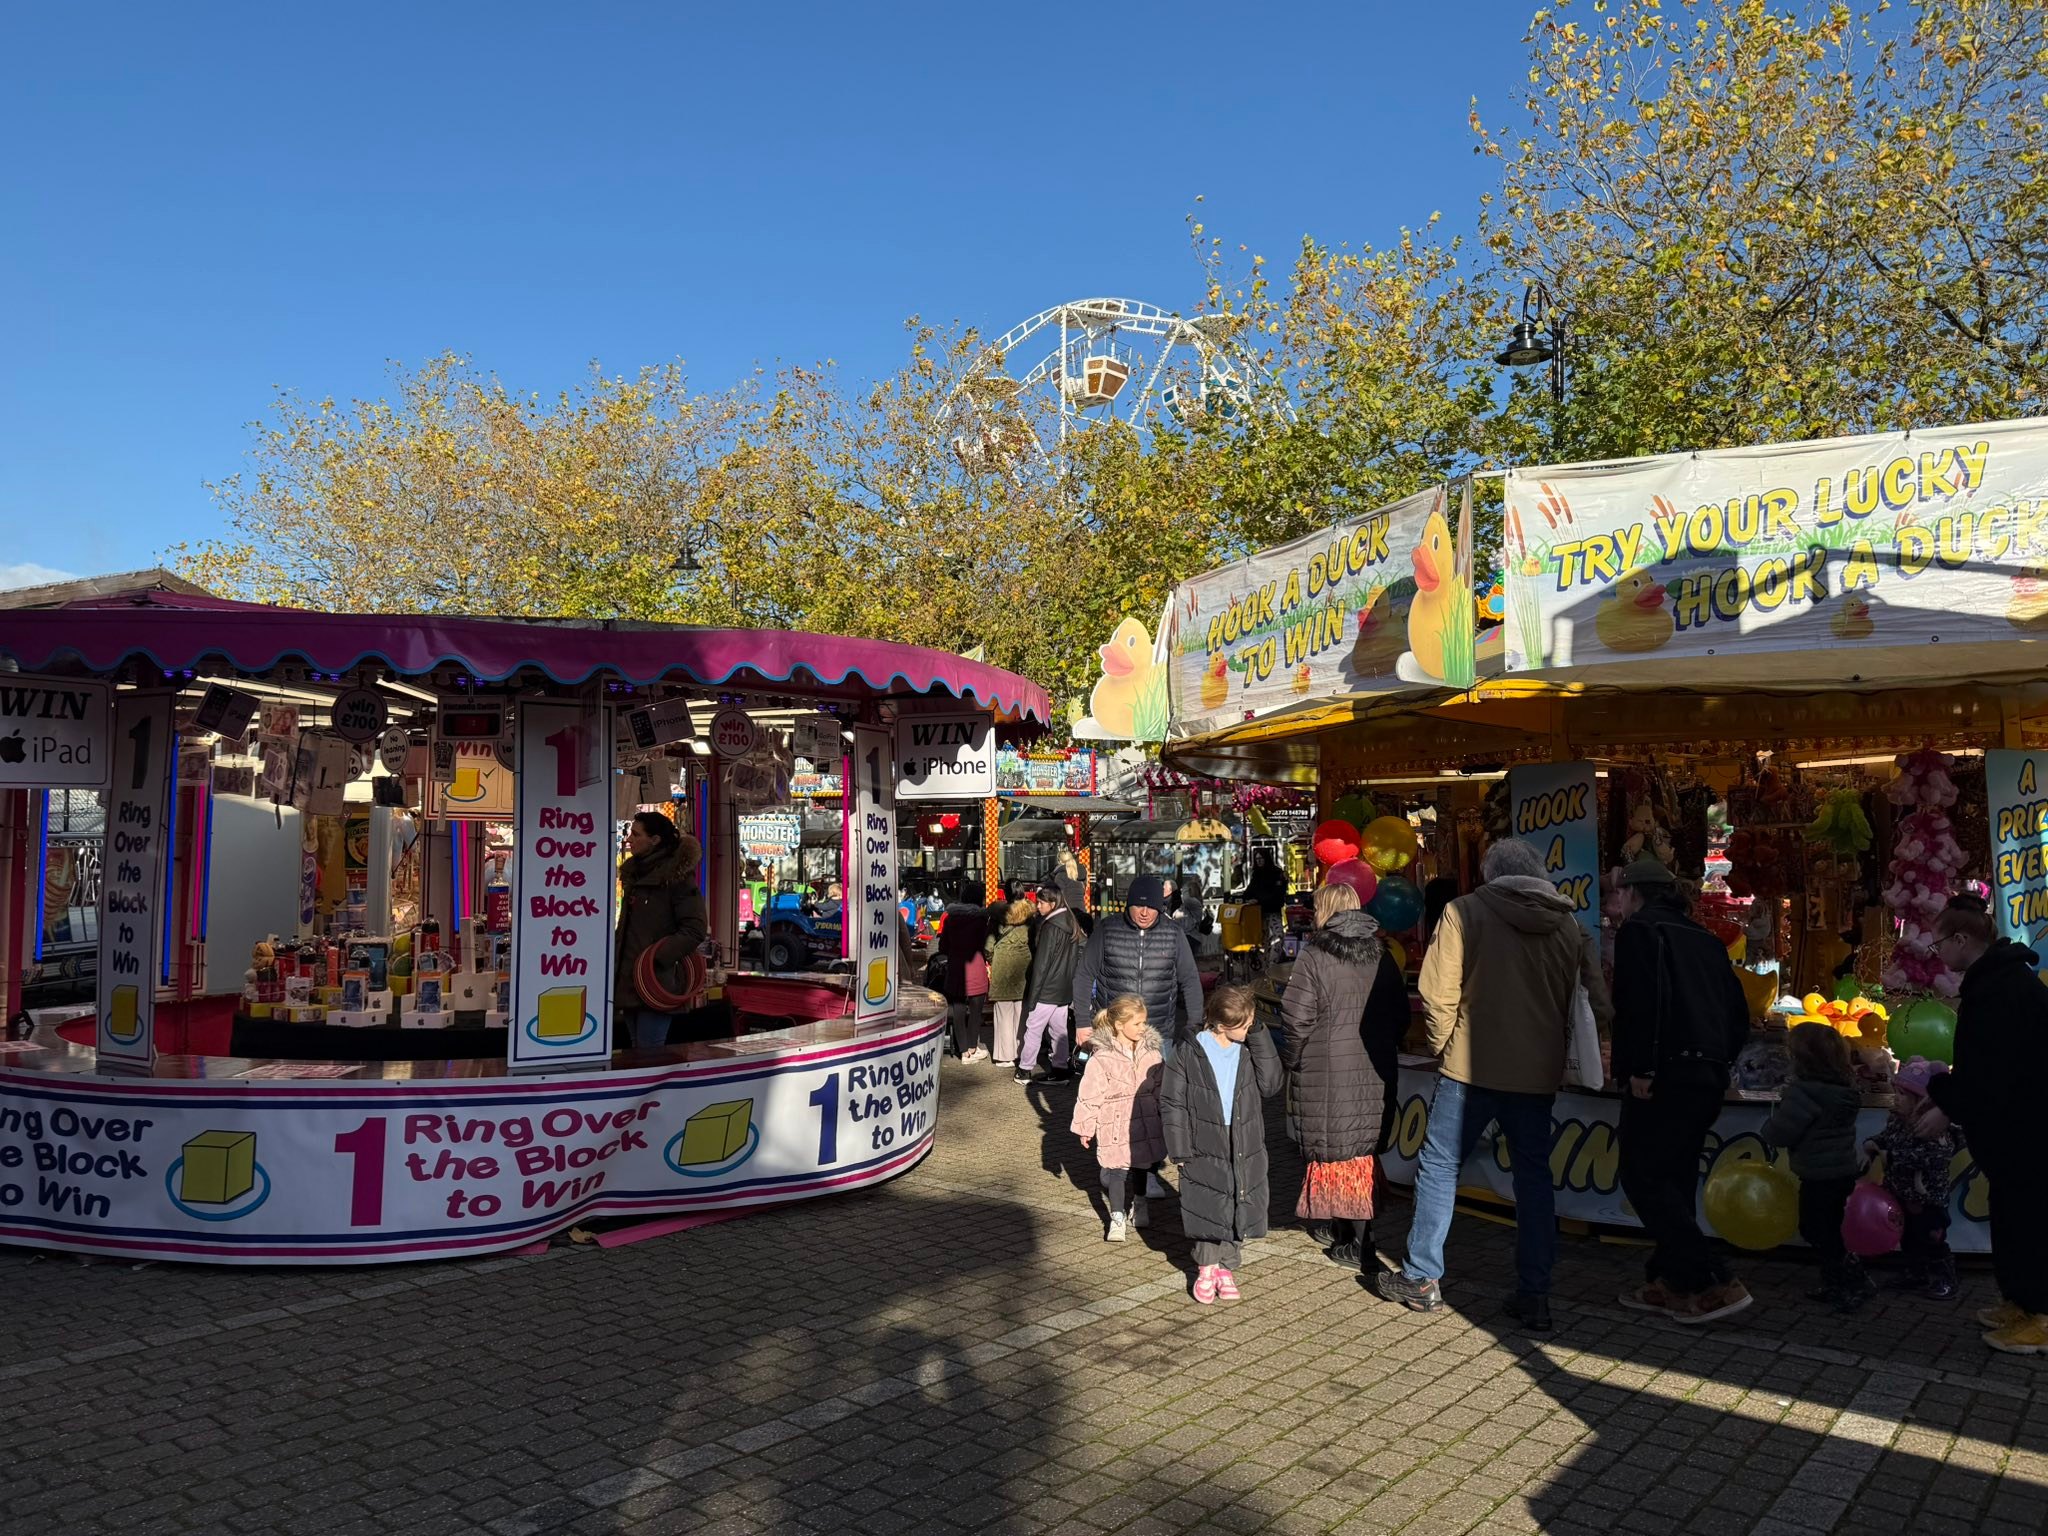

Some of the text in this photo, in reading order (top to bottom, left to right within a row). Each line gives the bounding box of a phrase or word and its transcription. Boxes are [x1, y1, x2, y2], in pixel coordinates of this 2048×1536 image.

[1551, 441, 1990, 592] TRY YOUR LUCKY
[1672, 498, 2048, 631] HOOK A DUCK
[1206, 512, 1391, 655] HOOK A DUCK
[1242, 598, 1346, 689] TO WIN
[0, 686, 92, 721] WIN
[346, 698, 376, 714] win
[340, 713, 378, 731] £100
[655, 715, 687, 728] iPhone
[720, 721, 746, 734] win
[911, 721, 979, 746] WIN
[32, 736, 92, 765] iPad
[128, 716, 152, 790] 1
[384, 743, 406, 755] leaning
[718, 733, 750, 747] £100
[545, 726, 581, 796] 1
[865, 745, 881, 804] 1
[923, 757, 987, 776] iPhone
[2018, 758, 2037, 796] A
[119, 801, 151, 828] Ring
[538, 807, 595, 836] Ring
[1517, 782, 1588, 835] HOOK
[1998, 799, 2048, 844] PRIZ
[740, 825, 795, 842] MONSTER
[866, 812, 889, 837] Ring
[115, 831, 150, 852] Over
[536, 836, 597, 859] Over
[866, 836, 890, 854] Over
[1545, 834, 1566, 873] A
[117, 860, 142, 884] the
[544, 865, 587, 889] the
[870, 859, 888, 878] the
[109, 890, 148, 915] Block
[865, 883, 893, 903] Block
[2008, 886, 2048, 928] TIM
[530, 896, 600, 919] Block
[873, 908, 885, 926] to
[119, 921, 134, 944] to
[551, 924, 578, 948] to
[869, 929, 889, 951] Win
[112, 948, 139, 976] Win
[540, 952, 588, 978] Win
[847, 1046, 937, 1094] Ring Over
[848, 1071, 936, 1124] the Block
[0, 1107, 153, 1142] ng Over
[403, 1100, 661, 1149] Ring Over
[808, 1072, 840, 1166] 1
[871, 1109, 927, 1151] to Win
[33, 1142, 148, 1179] Block
[405, 1130, 649, 1182] the Block
[334, 1116, 388, 1227] 1
[0, 1175, 111, 1218] o Win
[446, 1169, 606, 1219] to Win
